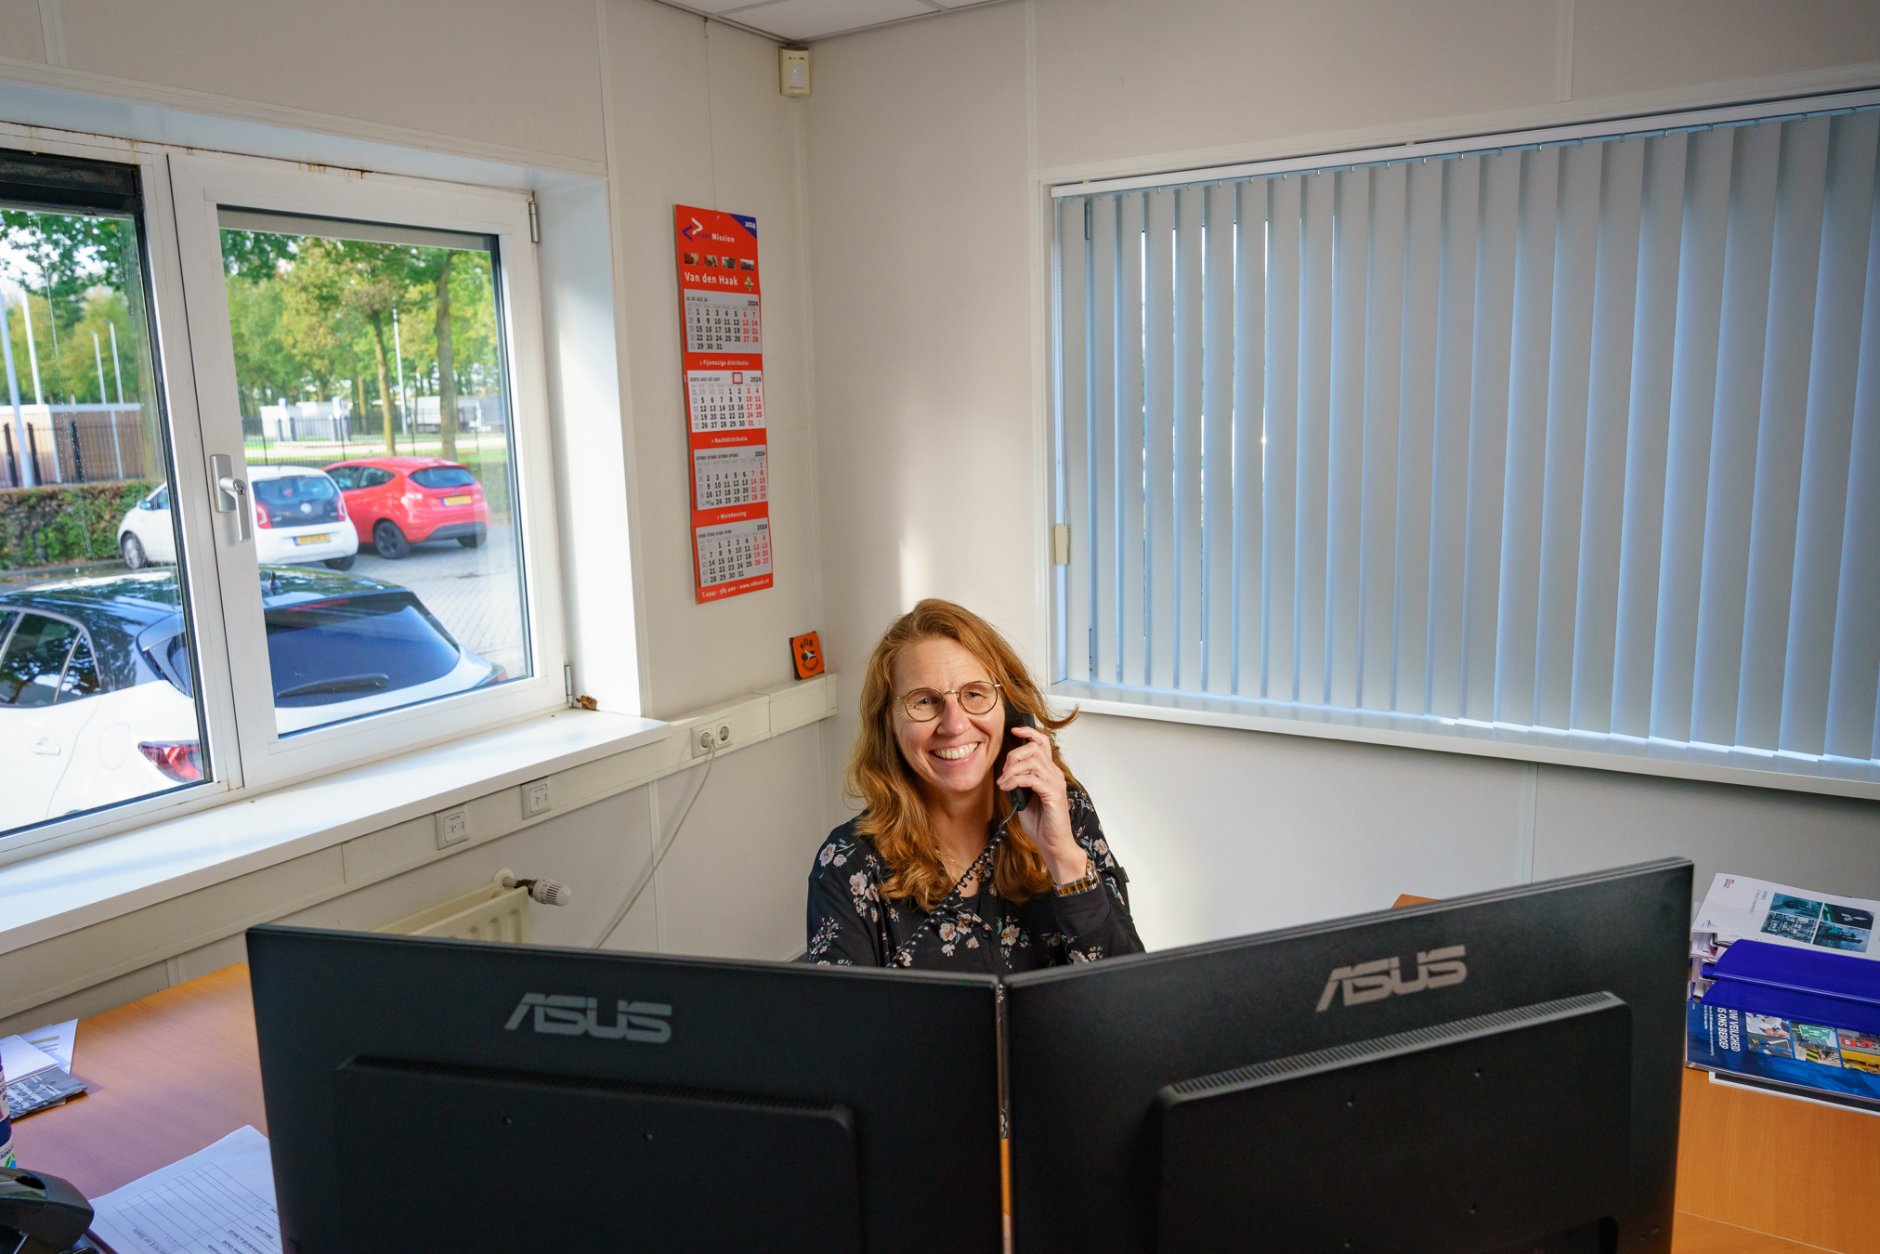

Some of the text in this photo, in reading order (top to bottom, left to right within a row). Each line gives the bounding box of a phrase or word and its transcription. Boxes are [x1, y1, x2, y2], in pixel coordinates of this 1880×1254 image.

[685, 272, 738, 286] Van den Haak
[1316, 944, 1467, 1012] ASUS
[504, 992, 672, 1044] ASUS
[1718, 1014, 1727, 1027] ONS
[1728, 1010, 1740, 1052] UW VEILIGHEID
[1718, 1028, 1729, 1050] BEROEP
